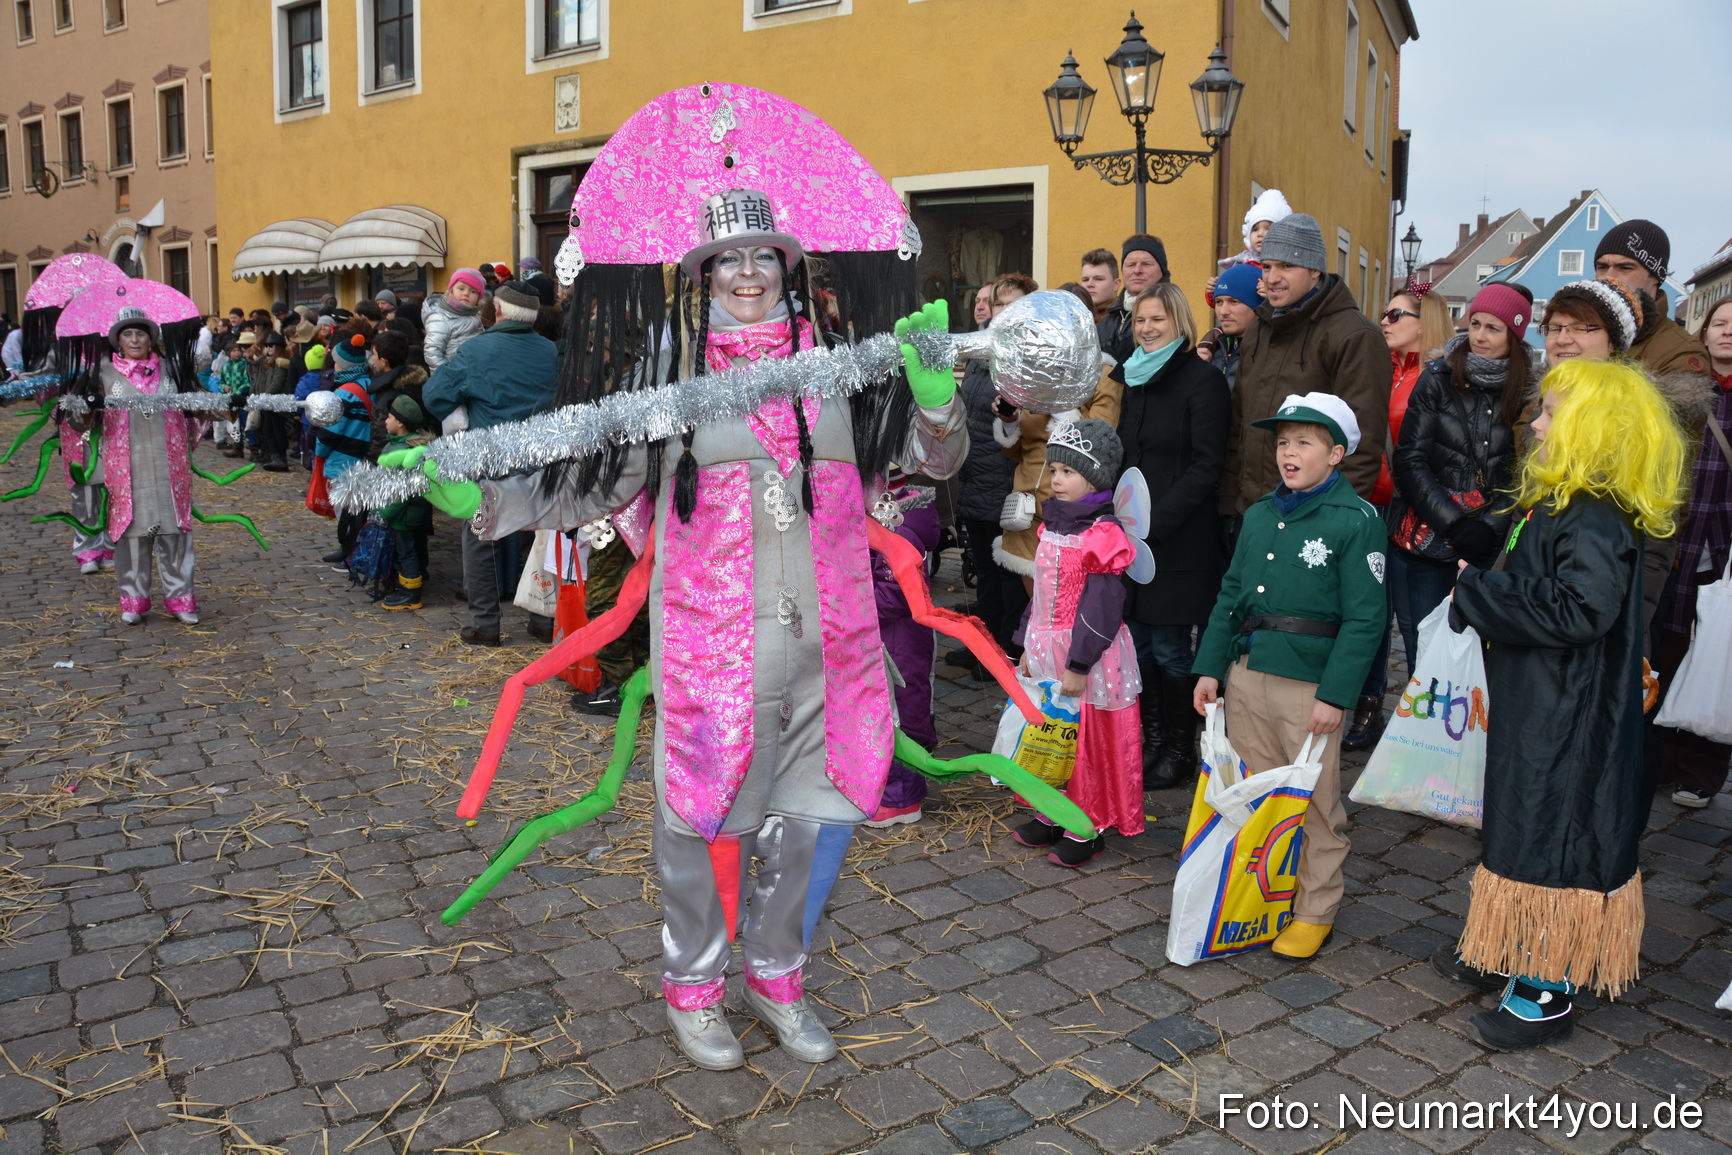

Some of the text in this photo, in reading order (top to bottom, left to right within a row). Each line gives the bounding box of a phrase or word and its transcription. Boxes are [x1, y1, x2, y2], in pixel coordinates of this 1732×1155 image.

[704, 195, 776, 241] 神韻
[1383, 731, 1398, 742] dass
[1399, 735, 1410, 745] Sie
[1411, 738, 1424, 748] bei
[1425, 743, 1439, 753] uns
[1431, 789, 1450, 801] Gut
